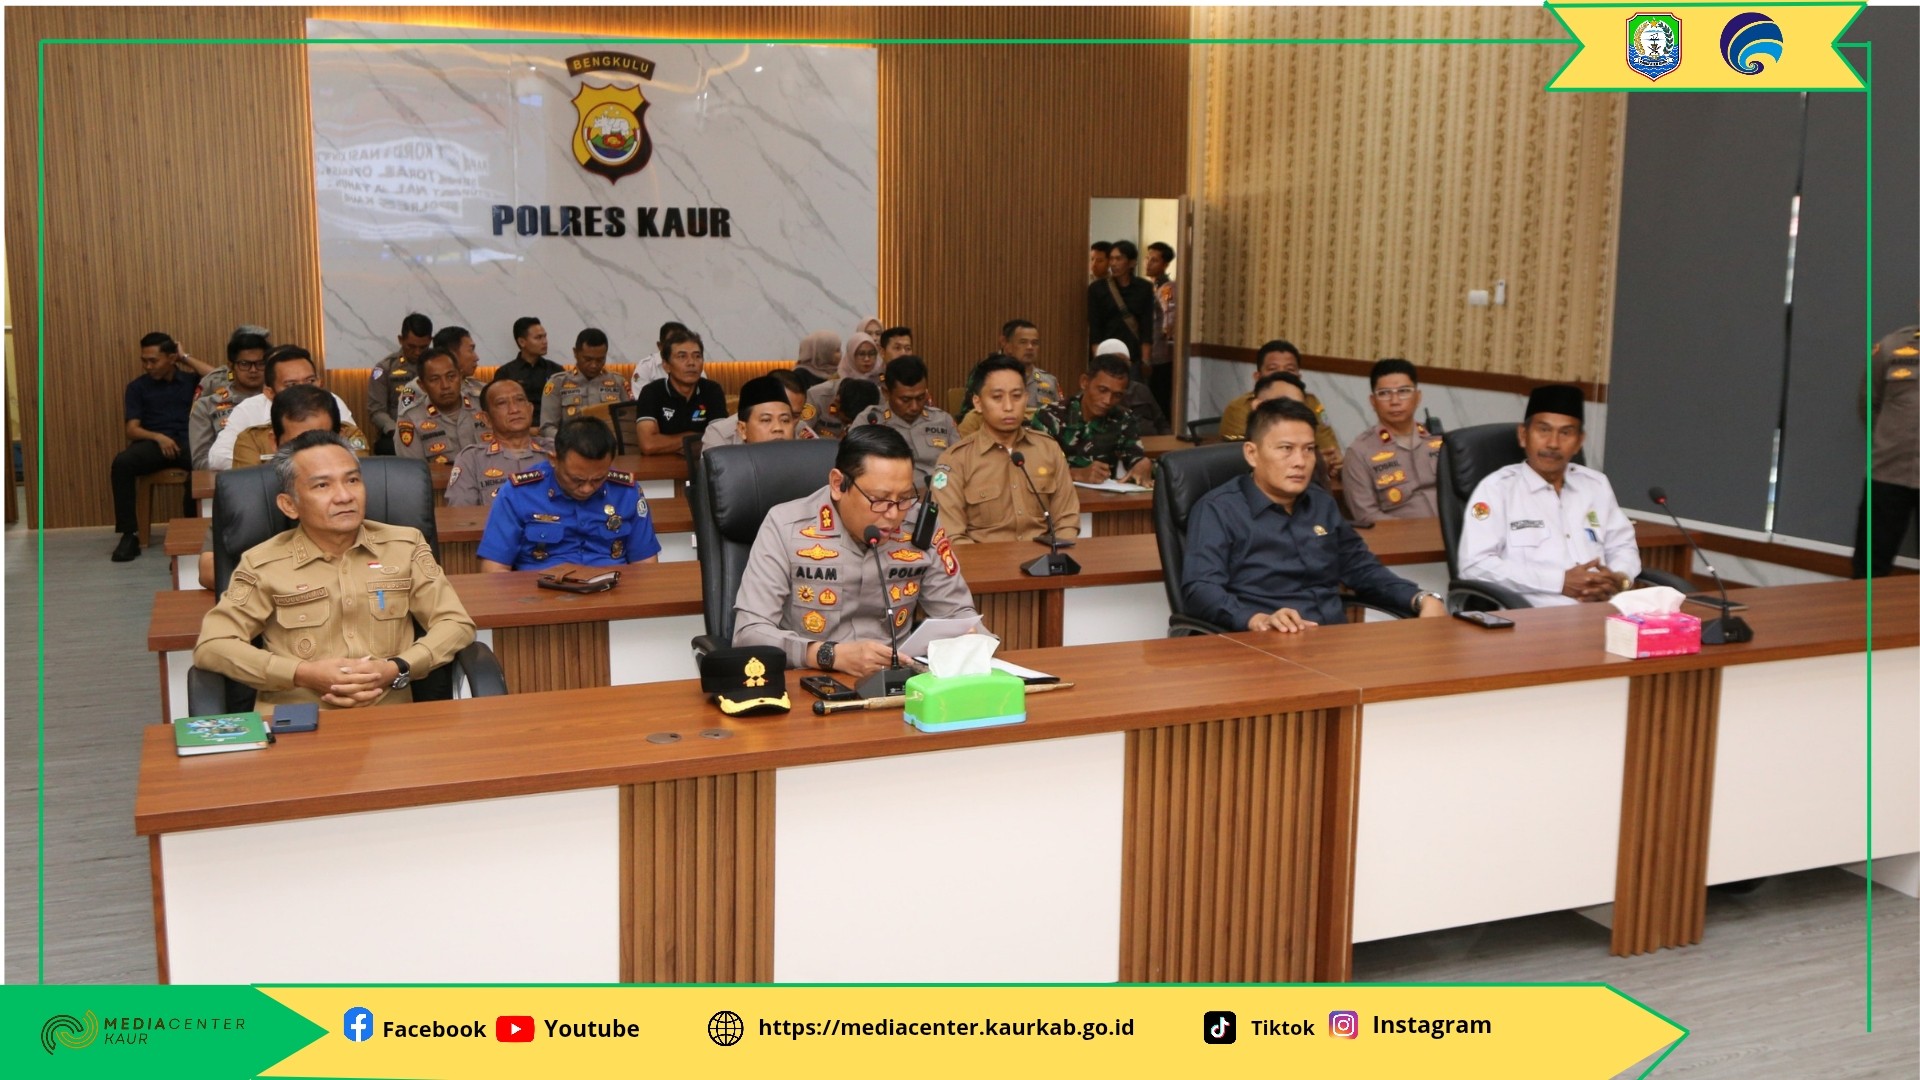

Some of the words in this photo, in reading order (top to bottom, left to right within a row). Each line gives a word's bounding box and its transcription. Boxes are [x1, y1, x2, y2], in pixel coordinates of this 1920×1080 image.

[572, 55, 650, 74] BENGKULU
[492, 205, 626, 238] POLRES
[637, 206, 731, 239] KAUR
[925, 426, 948, 436] POLRI
[796, 566, 837, 581] ALAM
[888, 566, 927, 579] POLRI
